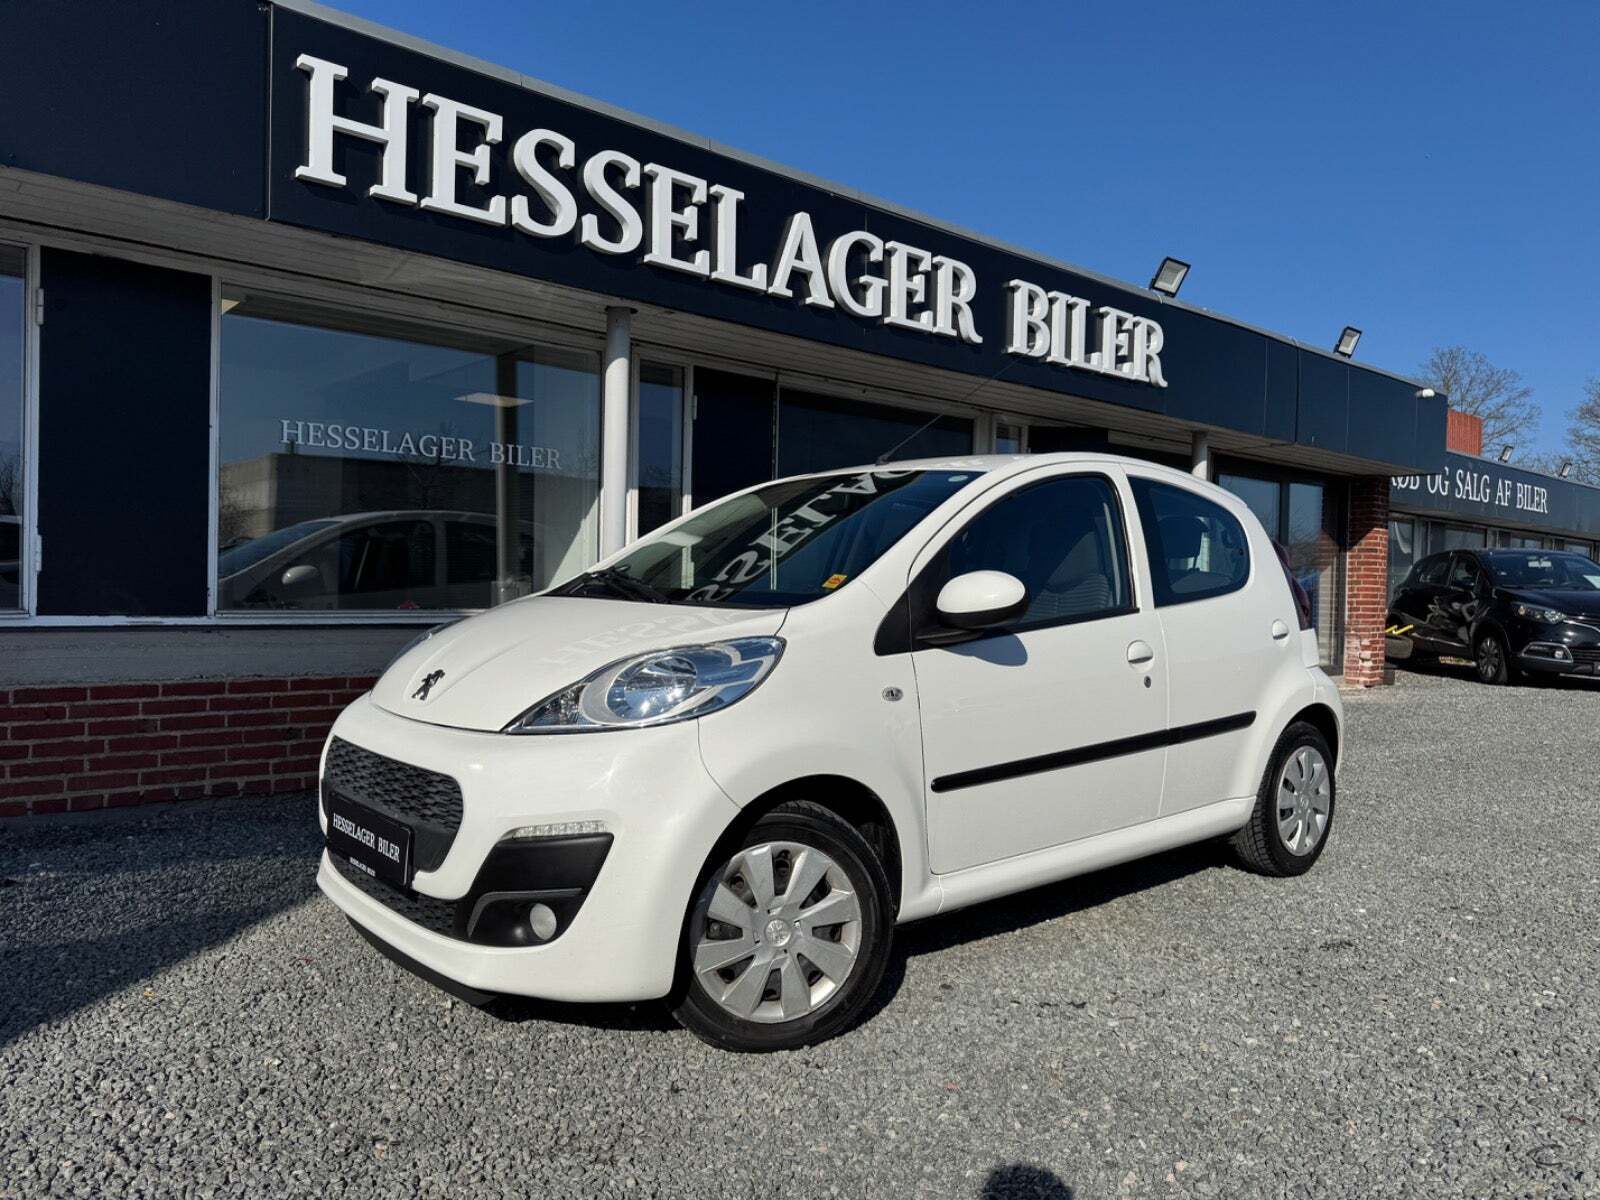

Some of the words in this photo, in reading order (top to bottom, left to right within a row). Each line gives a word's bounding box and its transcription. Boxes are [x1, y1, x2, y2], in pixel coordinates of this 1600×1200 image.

[294, 53, 984, 345] HESSELAGER
[1005, 278, 1169, 389] BILER
[280, 419, 476, 462] HESSELAGER
[489, 441, 563, 470] BILER
[1454, 469, 1491, 503] SALG
[1494, 478, 1512, 507] AF
[1515, 482, 1549, 514] BILER
[333, 813, 376, 849] HESSELAGER
[377, 837, 400, 863] BILER
